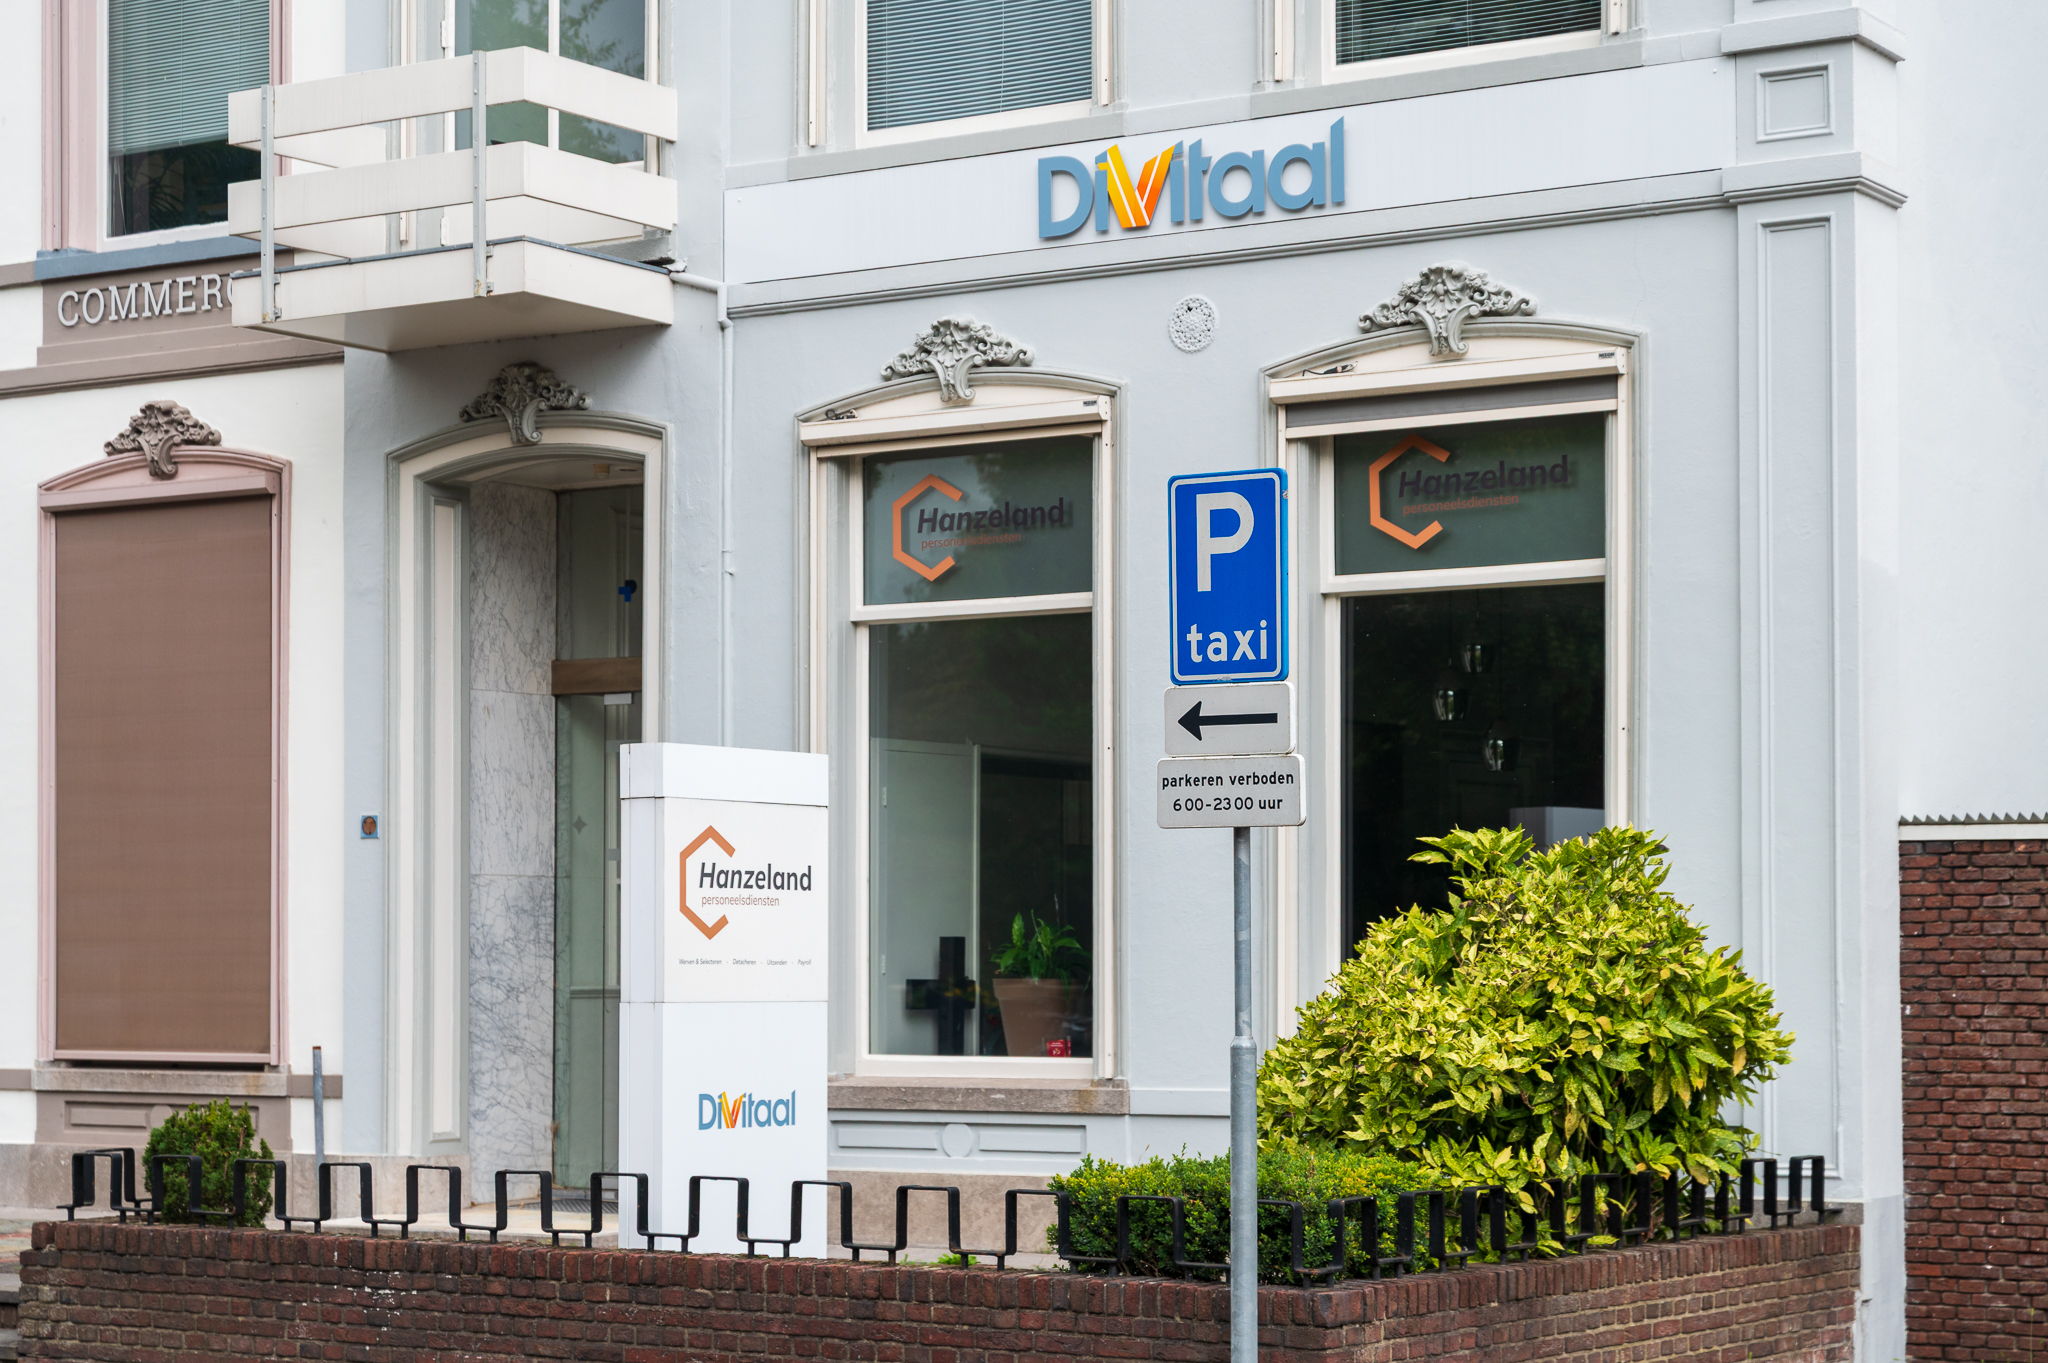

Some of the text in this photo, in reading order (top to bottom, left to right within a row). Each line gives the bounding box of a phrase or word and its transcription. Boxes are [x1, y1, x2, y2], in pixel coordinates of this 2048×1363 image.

[58, 270, 244, 327] COMMER
[1398, 454, 1569, 497] Hanzeland
[917, 497, 1064, 533] Hanzeland
[1403, 494, 1519, 517] personeelsdiensten
[921, 532, 1022, 551] personeelsdiensten
[1196, 491, 1255, 592] P
[1187, 619, 1268, 663] taxi
[1162, 771, 1294, 790] parkeren verboden
[1258, 798, 1283, 809] uur
[699, 862, 812, 891] Hanzeland
[702, 894, 780, 907] personeelsdiensten
[797, 959, 812, 967] Payroll
